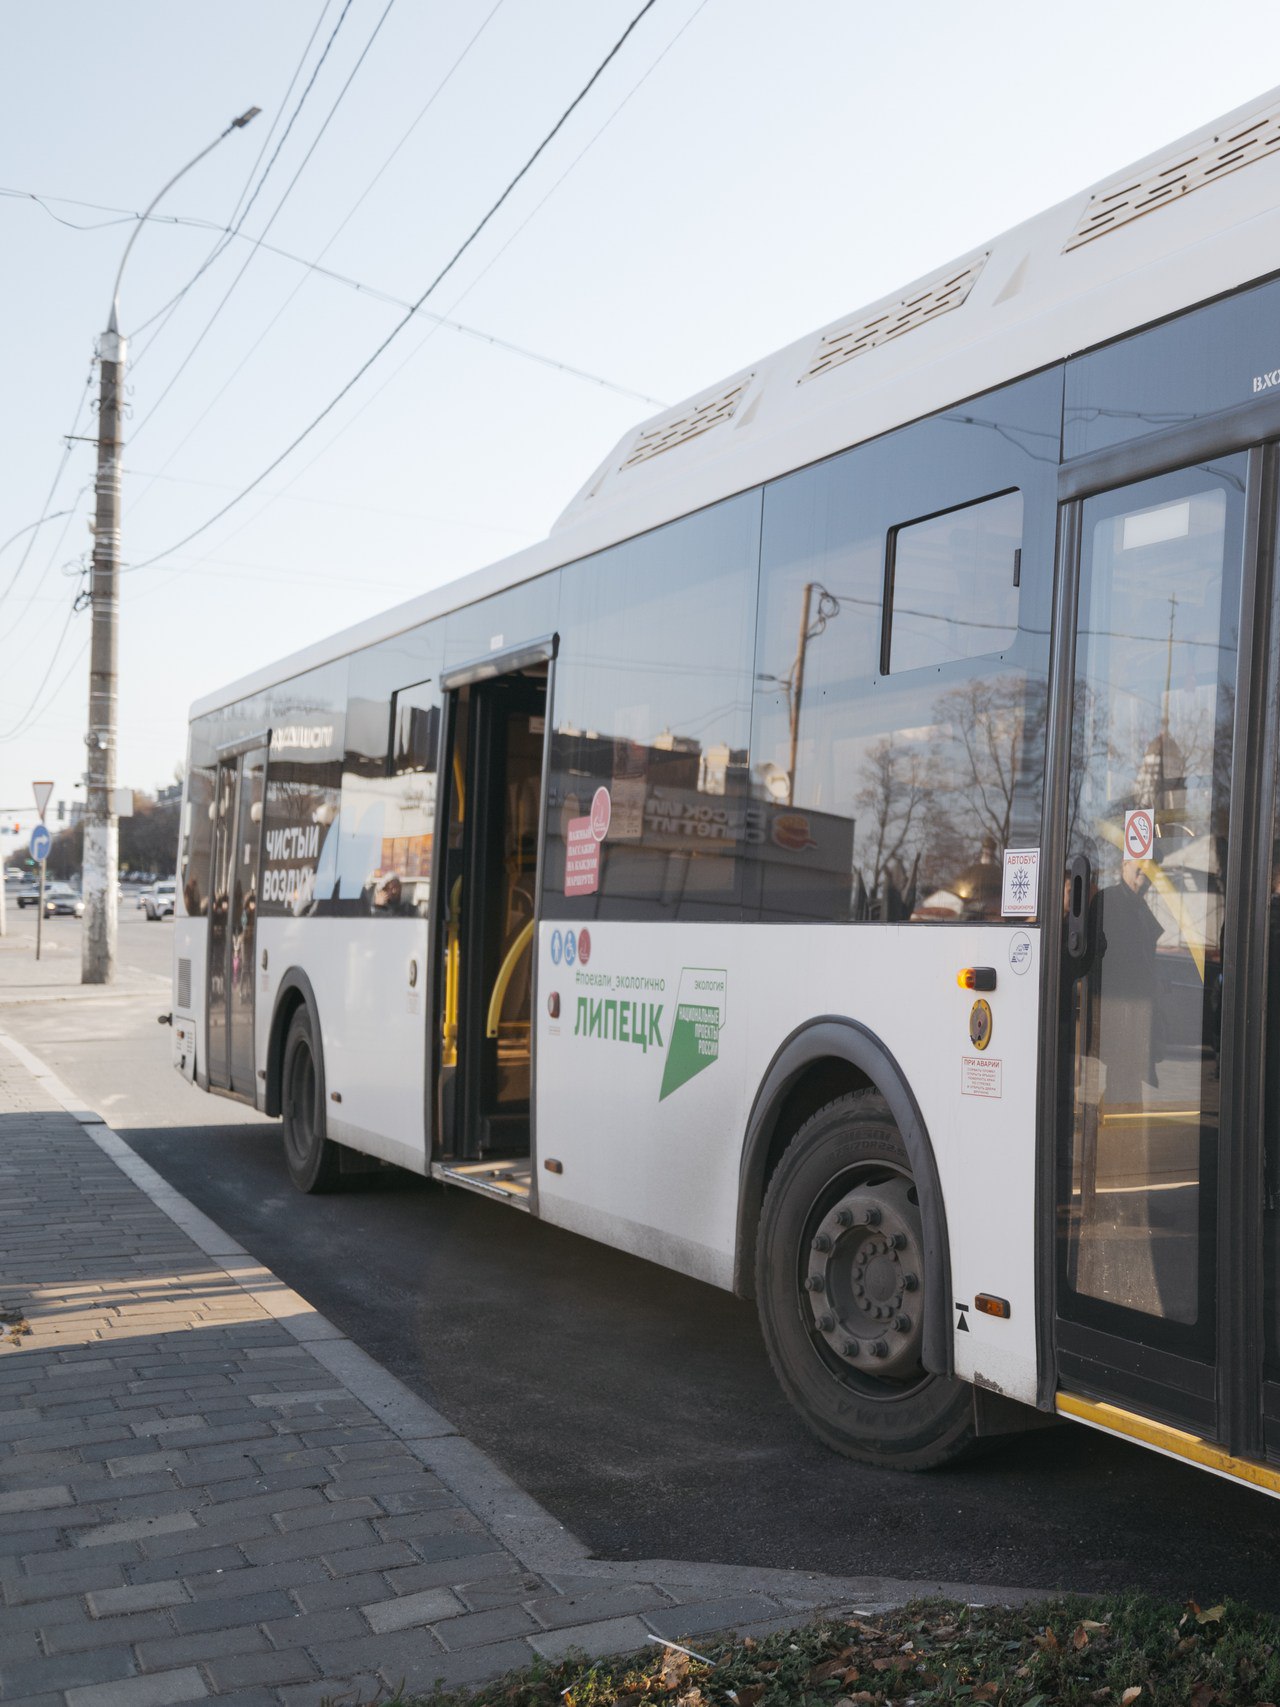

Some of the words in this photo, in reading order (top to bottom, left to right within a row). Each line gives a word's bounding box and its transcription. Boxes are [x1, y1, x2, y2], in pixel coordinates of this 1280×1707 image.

[1007, 855, 1037, 865] АВТОБУС
[574, 996, 664, 1054] ЛИПЕЦК
[977, 1060, 999, 1068] АВАРИИ
